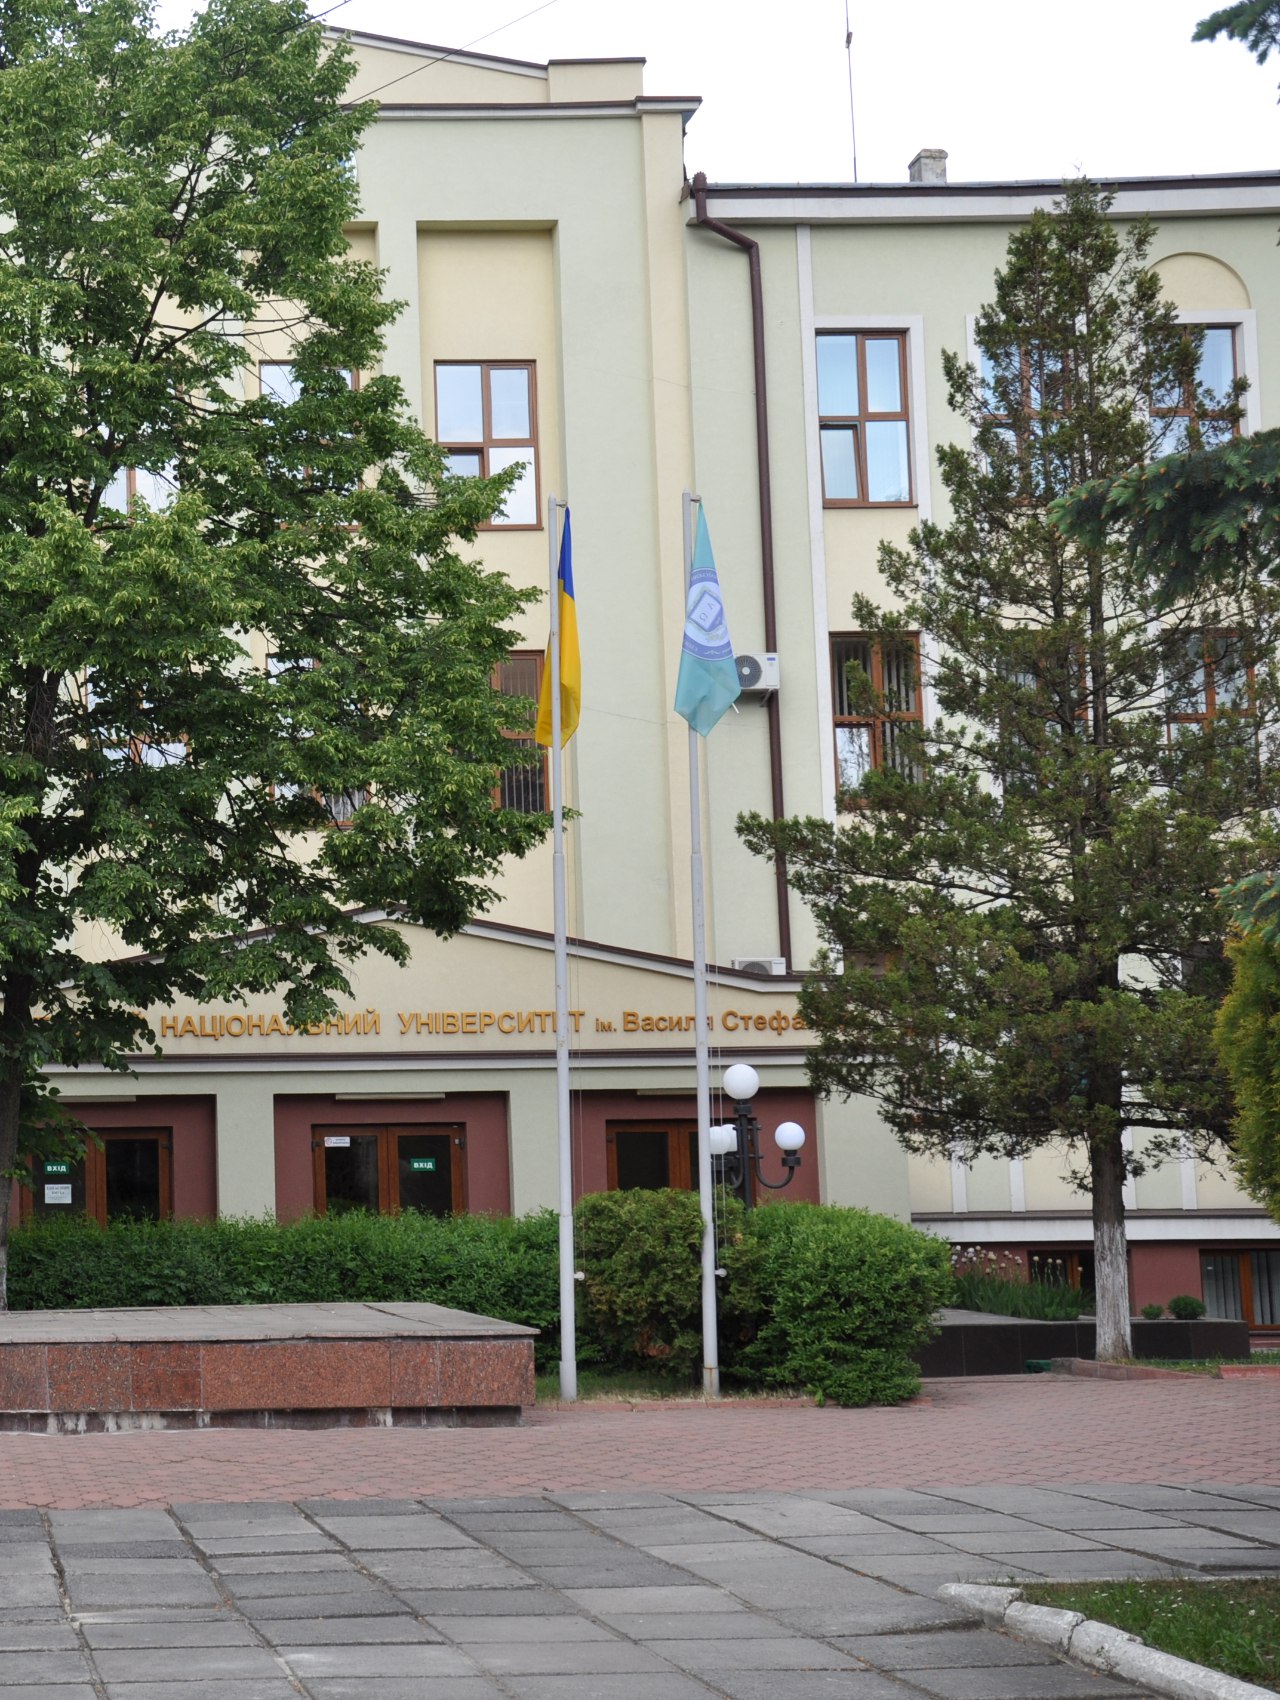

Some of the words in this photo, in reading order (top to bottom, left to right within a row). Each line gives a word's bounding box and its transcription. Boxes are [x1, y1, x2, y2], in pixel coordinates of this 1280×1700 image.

[397, 1010, 585, 1035] УНІВЕРСИТТ
[595, 1017, 618, 1033] ім.
[721, 1010, 807, 1036] Стефа
